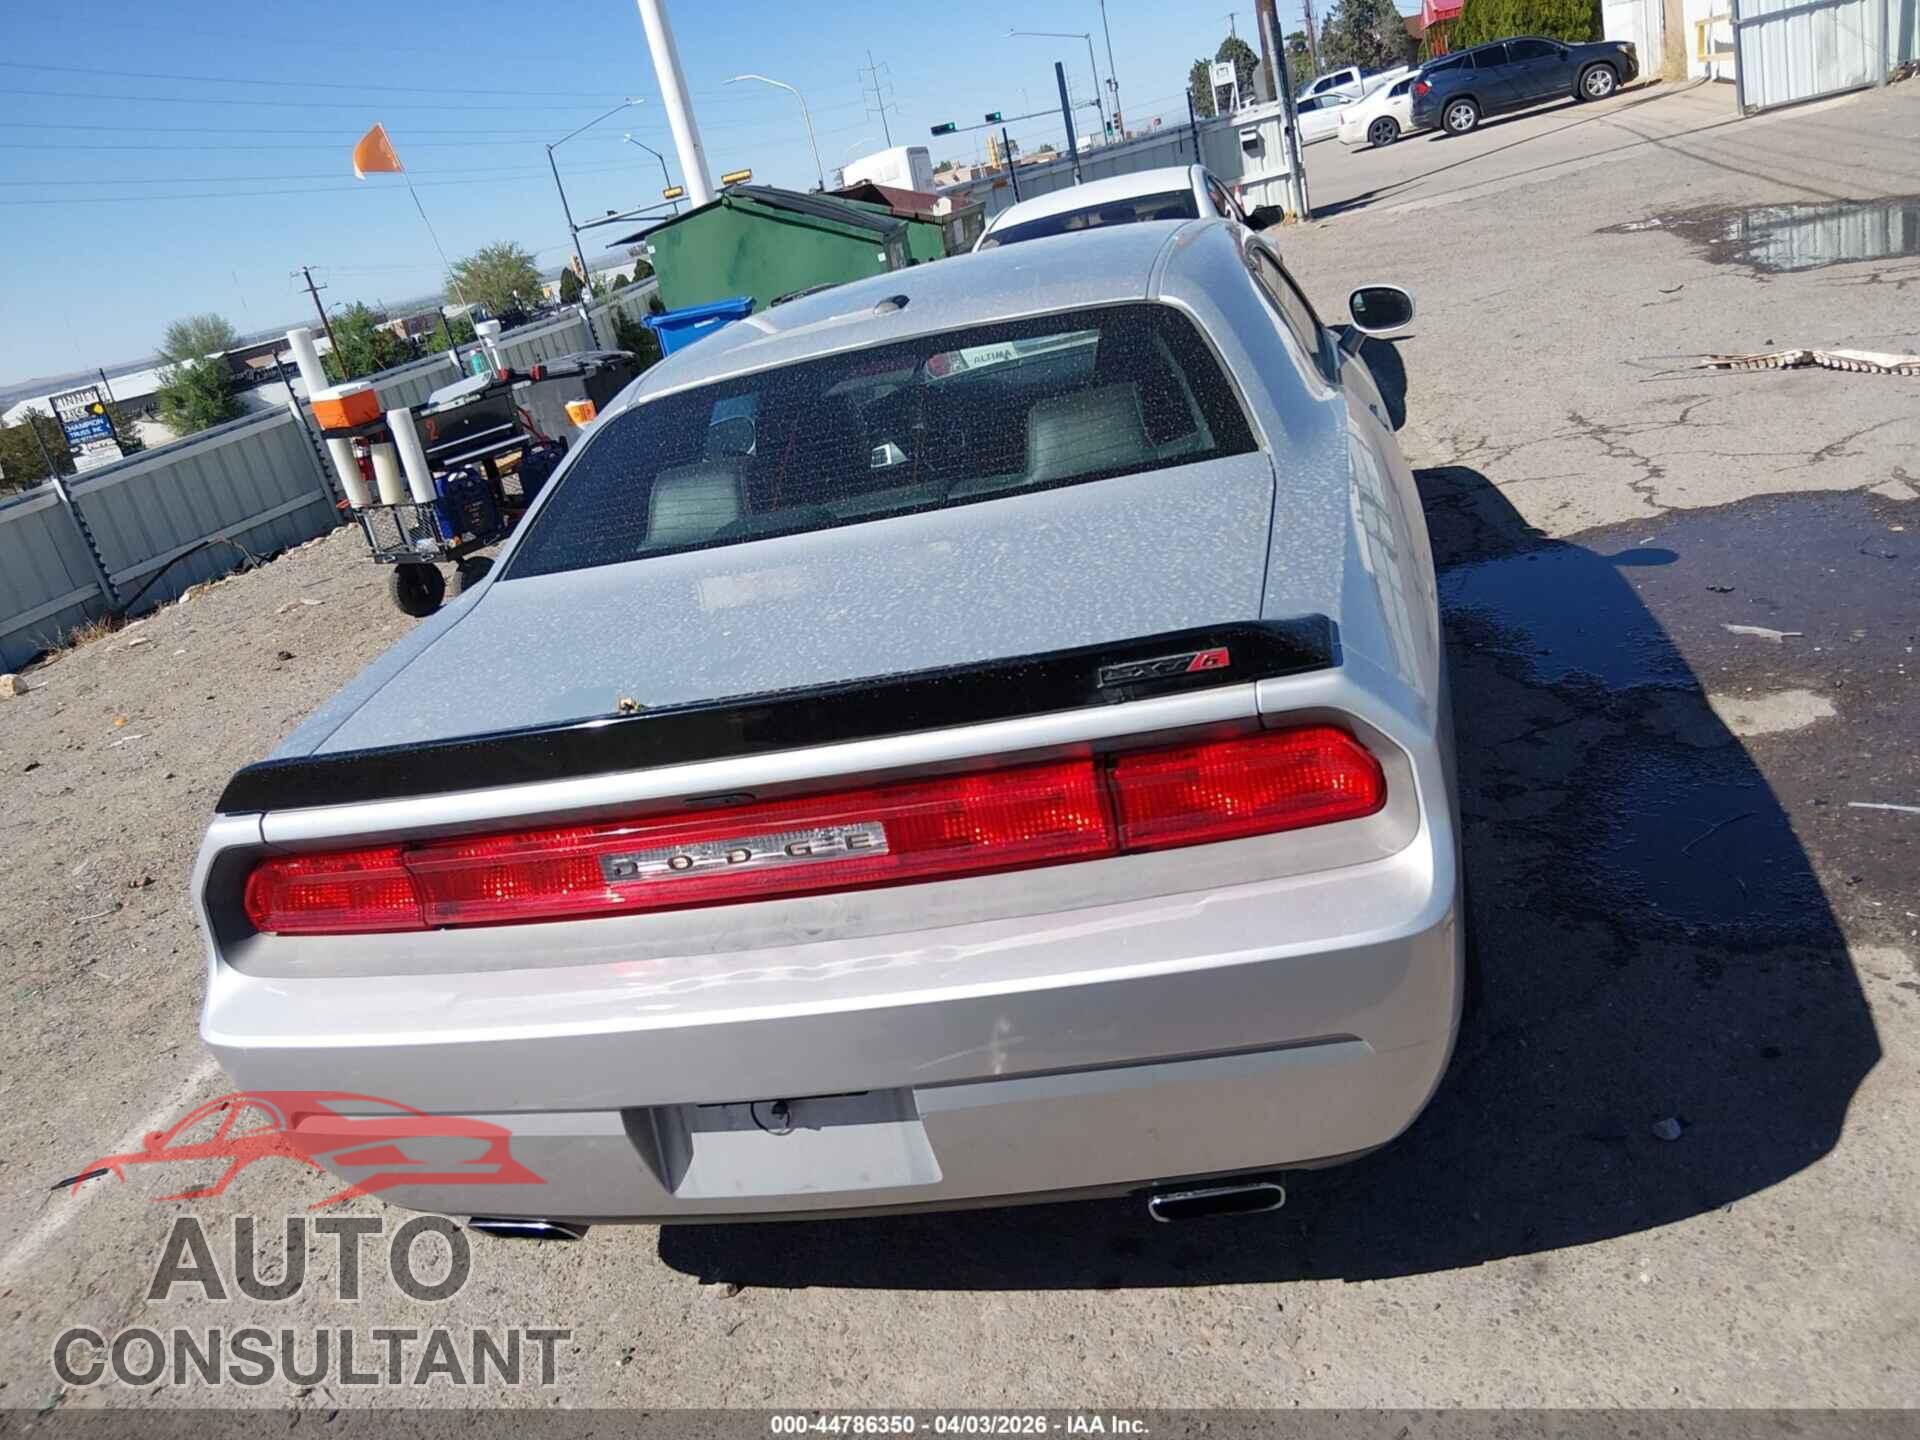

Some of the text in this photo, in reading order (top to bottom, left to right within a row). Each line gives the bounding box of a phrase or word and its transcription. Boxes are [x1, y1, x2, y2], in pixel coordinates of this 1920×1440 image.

[974, 350, 1013, 364] ALTIMA
[64, 418, 104, 432] CHAMPION
[613, 832, 872, 876] DODGE
